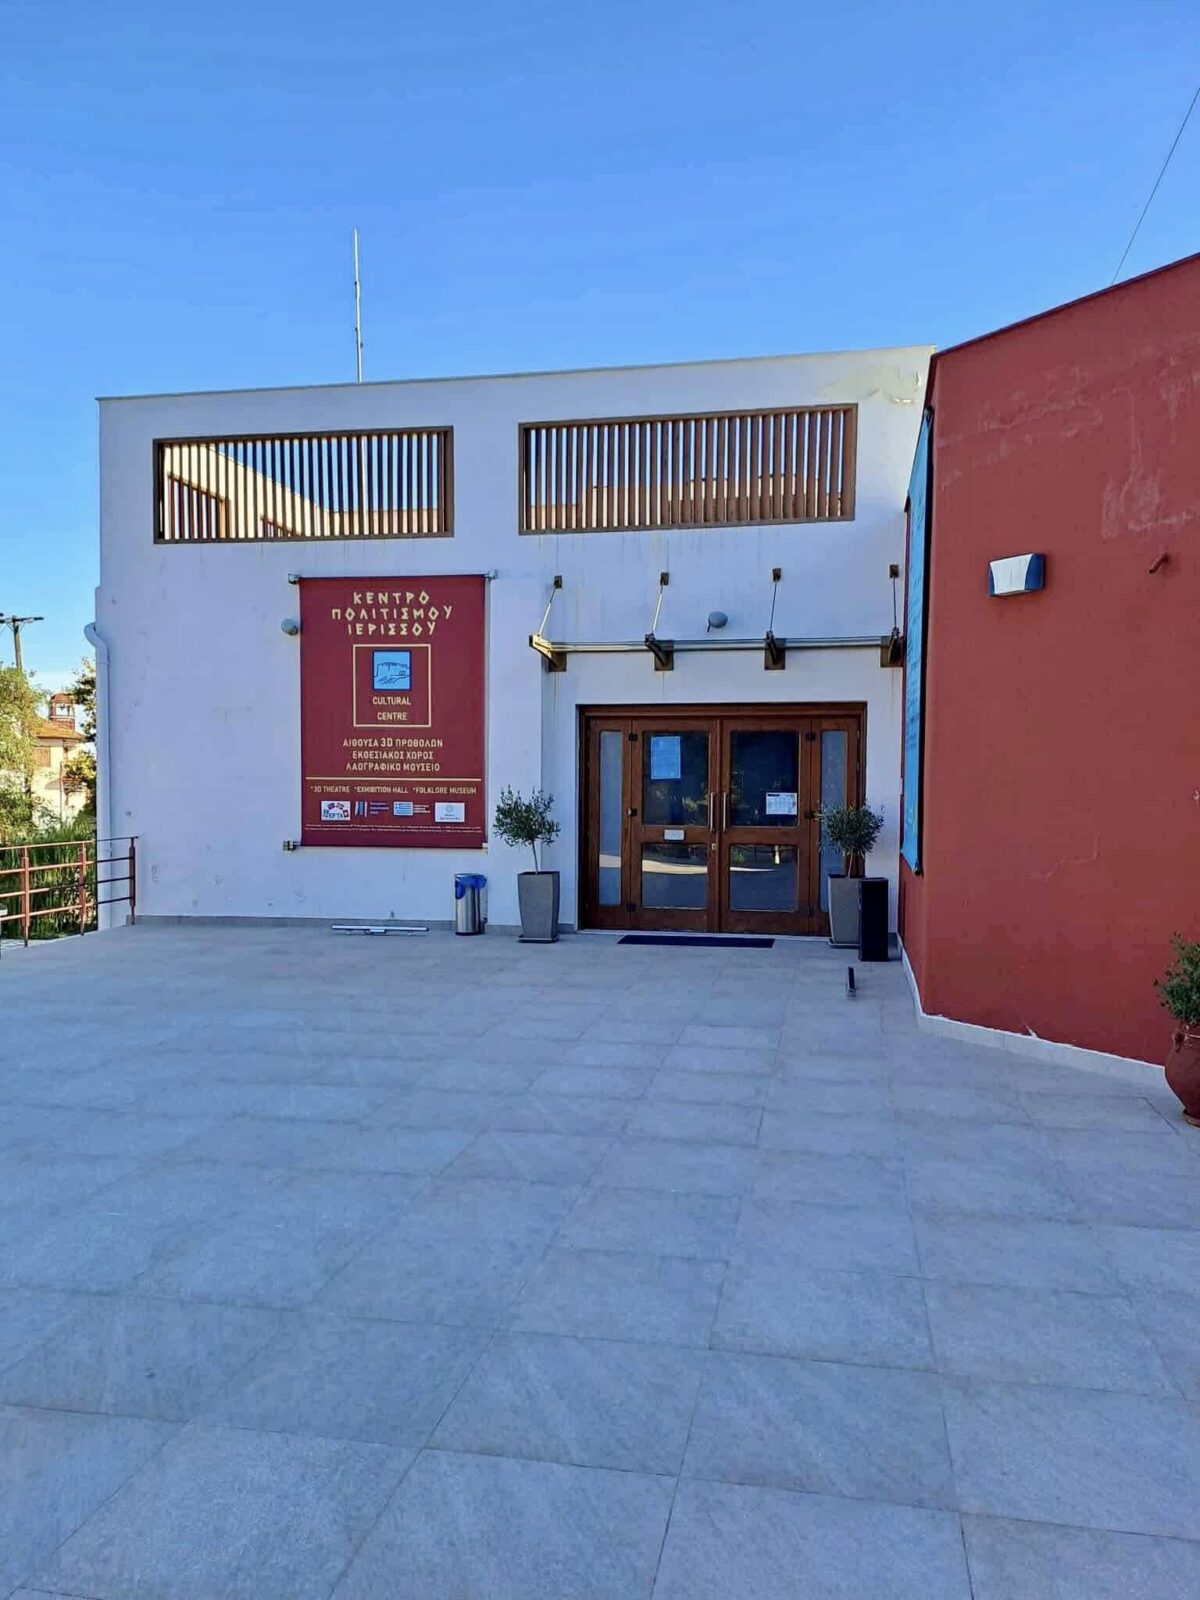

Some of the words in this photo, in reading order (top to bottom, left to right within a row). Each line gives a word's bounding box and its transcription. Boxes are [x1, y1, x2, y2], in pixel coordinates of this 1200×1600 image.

[353, 589, 430, 605] ΚΕΝΤΡΟ
[331, 605, 453, 621] ΠΟΛΙΤΙΣΜΟΥ
[347, 621, 436, 636] ΙΕΡΙΣΣΟΥ
[372, 696, 412, 706] CULTURAL
[377, 712, 408, 721] CENTRE
[342, 738, 379, 748] ΑΙΘΟΥΣΑ
[380, 737, 393, 748] 3D
[395, 738, 444, 748] ΠΡΟΒΟΛΩΝ
[352, 750, 405, 760] ΕΚΘΕΣΙΑΚΟΣ
[406, 751, 434, 760] ΧΩΡΟΣ
[346, 762, 401, 772] ΛΑΟΓΡΑΦΙΚΟ
[403, 763, 441, 772] ΜΟΥΣΕΙΟ
[324, 785, 350, 793] THEATRE
[392, 786, 409, 794] HALL
[449, 786, 477, 795] MUSEUM
